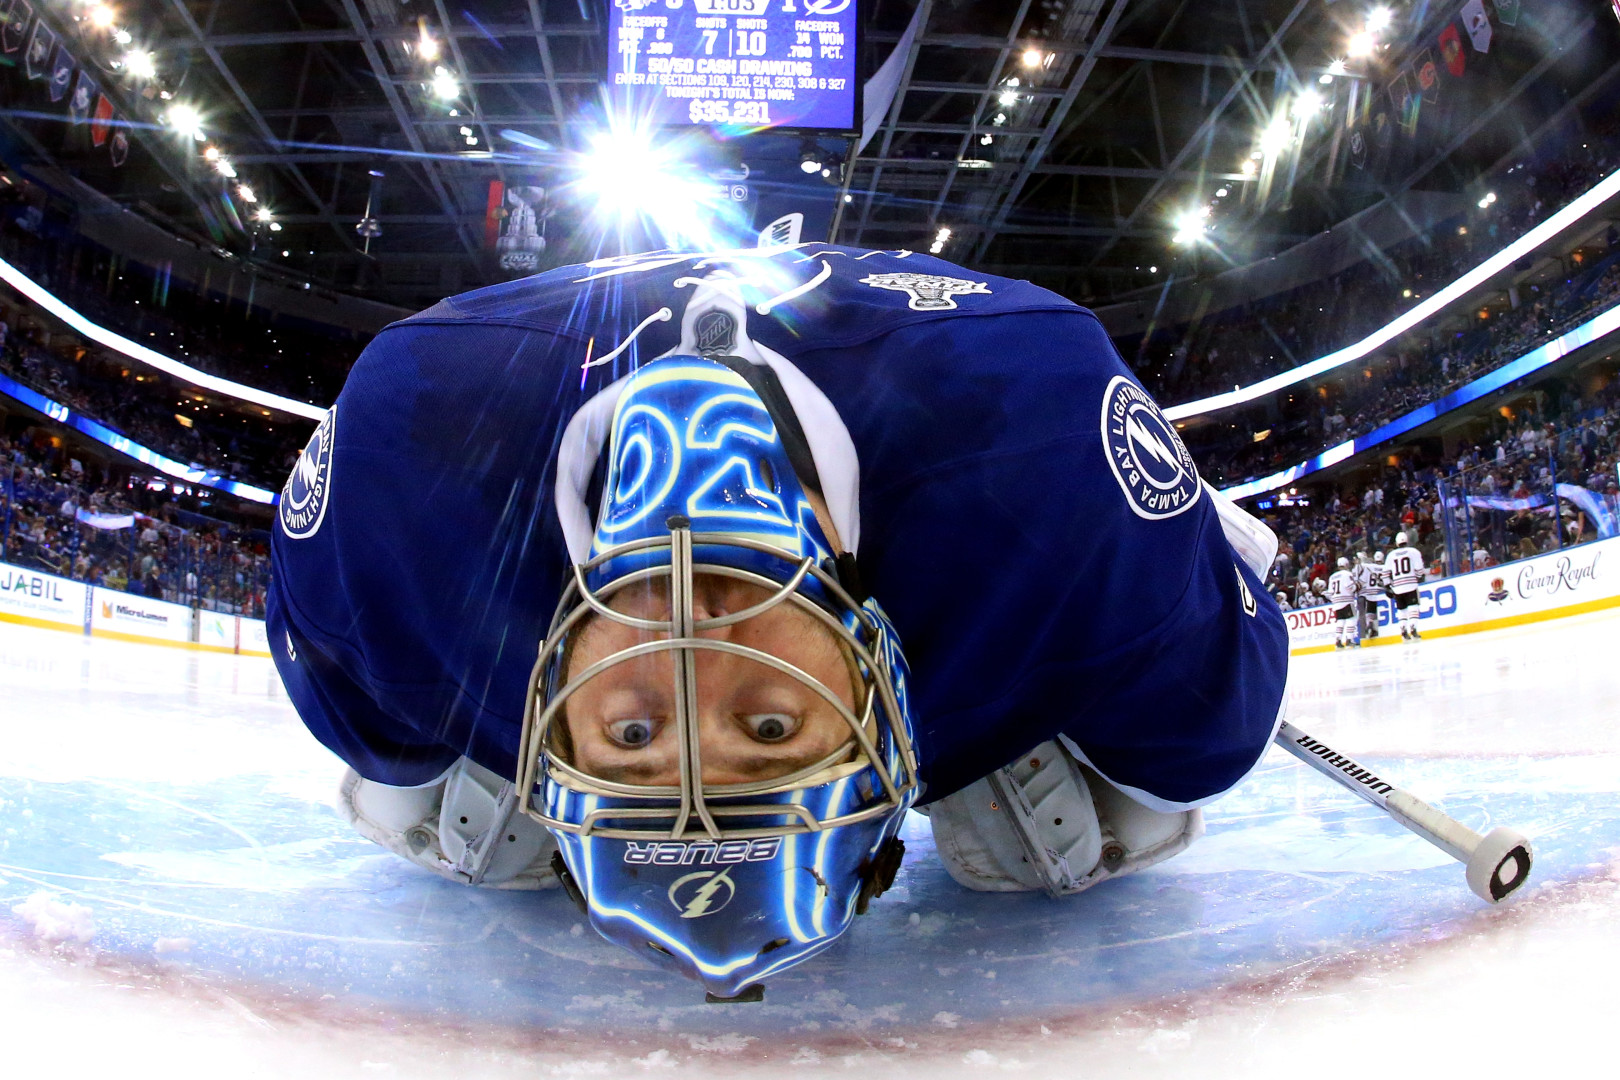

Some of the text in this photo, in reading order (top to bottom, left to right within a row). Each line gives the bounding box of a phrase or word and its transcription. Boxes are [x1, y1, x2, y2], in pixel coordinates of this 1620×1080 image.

[623, 16, 668, 27] FACEOFFS
[696, 17, 727, 29] SHOTS
[736, 18, 768, 30] SHOTS
[795, 20, 840, 32] FACEOFFS
[702, 30, 718, 55] 7
[736, 31, 767, 56] 10
[819, 32, 844, 45] WON
[821, 45, 844, 59] PCT.
[648, 57, 812, 76] 50/50 CASH DRAWING
[615, 73, 645, 84] ENTER
[646, 74, 659, 84] AT
[660, 74, 707, 86] SECTIONS
[721, 87, 753, 99] TOTAL
[754, 89, 766, 99] IS
[689, 98, 771, 125] $35,231
[1112, 386, 1159, 436] LIGHTNING
[1115, 445, 1141, 488] BAY
[286, 463, 327, 529] LIGHTNING
[1141, 484, 1190, 510] TAMPA
[1394, 556, 1411, 576] 10
[1517, 551, 1602, 599] Crown Royal
[0, 571, 63, 602] JABIL
[1288, 607, 1338, 630] ONDA
[623, 837, 782, 865] BAUER
